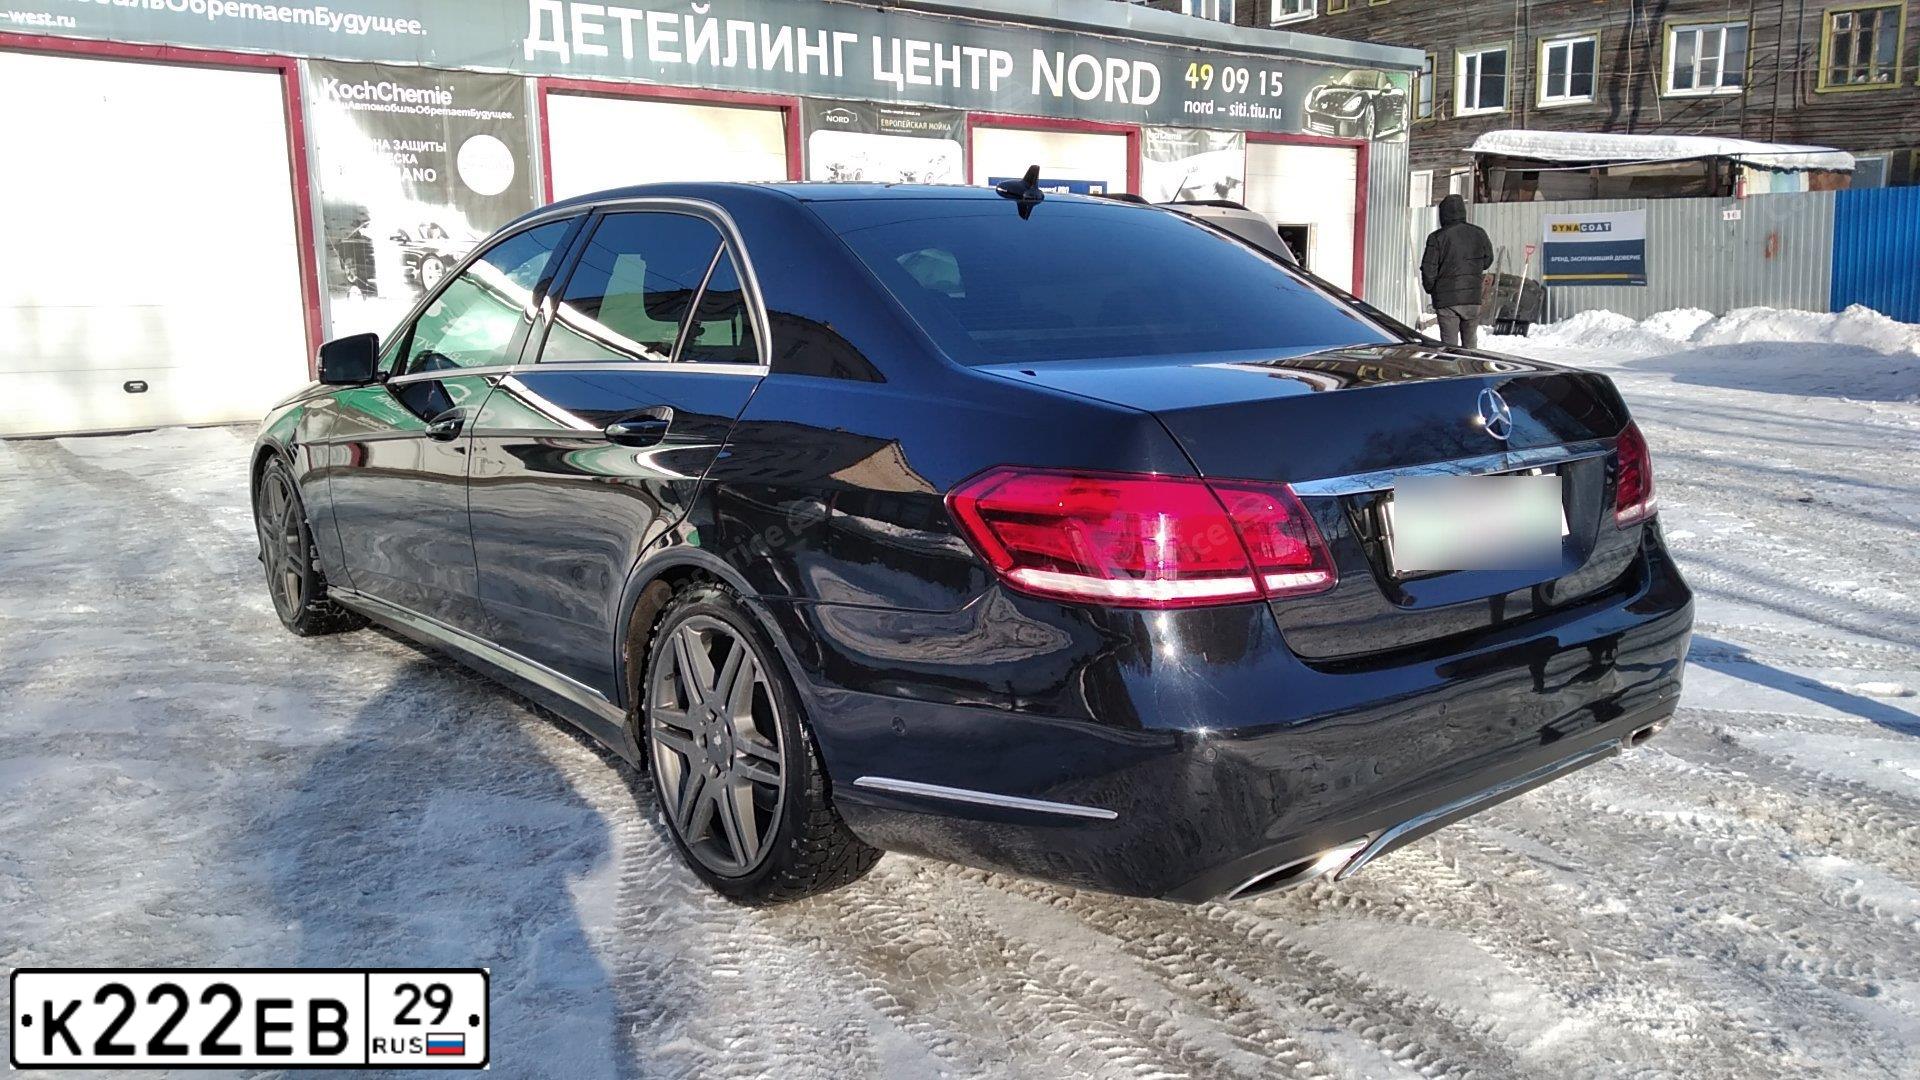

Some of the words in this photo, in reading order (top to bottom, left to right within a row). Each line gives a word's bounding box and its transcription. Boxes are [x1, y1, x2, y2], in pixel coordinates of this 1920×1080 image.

[523, 0, 858, 77] ДЕТЕЙЛИНГ
[872, 35, 1014, 92] ЦЕНТР
[1031, 48, 1161, 105] NORD
[1185, 63, 1214, 91] 49
[1222, 66, 1249, 94] 09
[1259, 70, 1283, 97] 15
[1184, 100, 1214, 115] nord
[1229, 101, 1282, 120] siti.tiu.ru
[826, 115, 850, 124] NORD
[880, 118, 927, 130] ЕВРОПЕЙСКАЯ
[928, 121, 951, 131] МОЙКА
[393, 139, 447, 153] ЗАЩИТЫ
[401, 167, 437, 182] ANO
[1551, 223, 1610, 232] DYNACOAT
